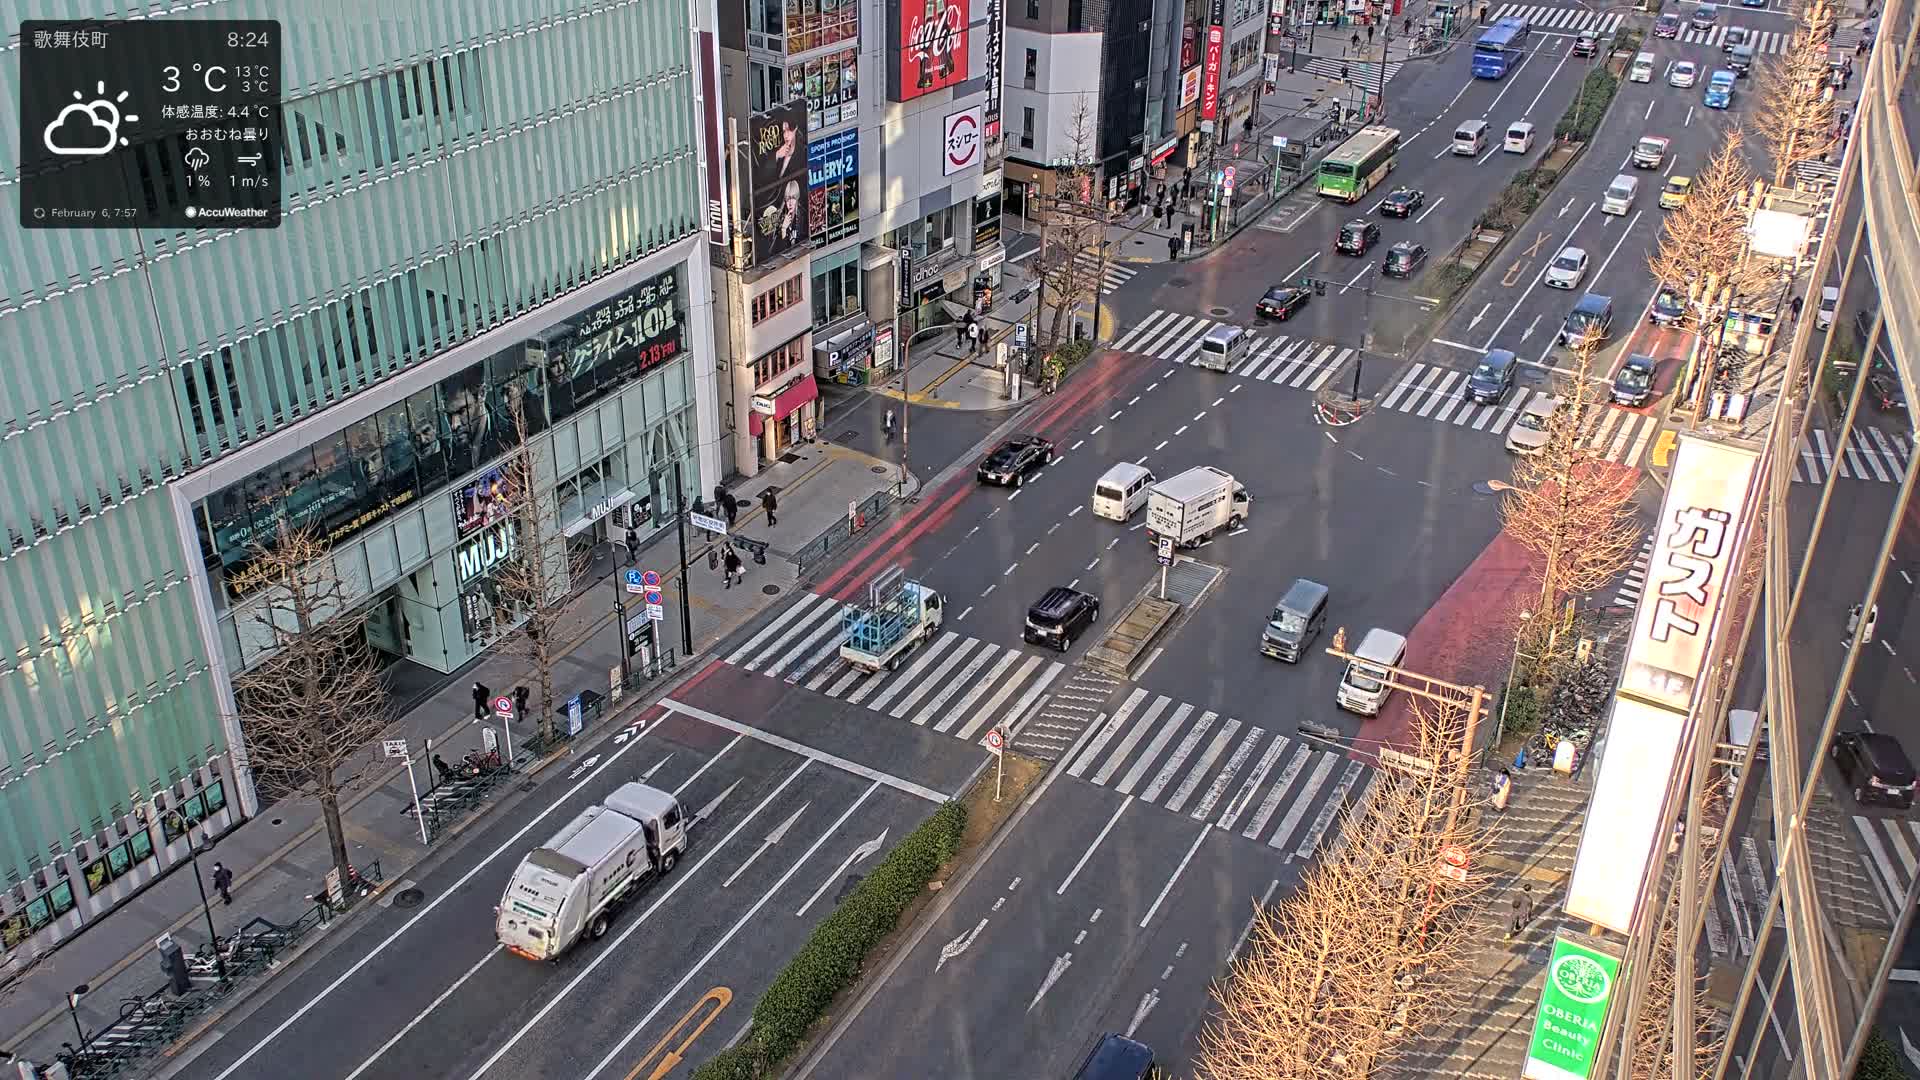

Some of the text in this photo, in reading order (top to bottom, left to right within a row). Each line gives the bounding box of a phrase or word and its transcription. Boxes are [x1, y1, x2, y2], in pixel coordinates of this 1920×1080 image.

[1205, 46, 1220, 110] バーガーキング
[947, 132, 979, 152] スシロー
[808, 154, 853, 186] ALLERY-2
[709, 199, 722, 233] MUJI
[1017, 325, 1025, 335] P
[830, 351, 839, 367] P
[592, 497, 615, 520] MUJI
[459, 522, 515, 581] MUJI
[1160, 539, 1169, 549] P
[1649, 506, 1732, 643] ガスト
[1559, 969, 1601, 991] OBERIA
[1543, 1003, 1598, 1033] OBERIA
[1543, 1018, 1592, 1047] Beauty
[1542, 1038, 1584, 1062] Clinic
